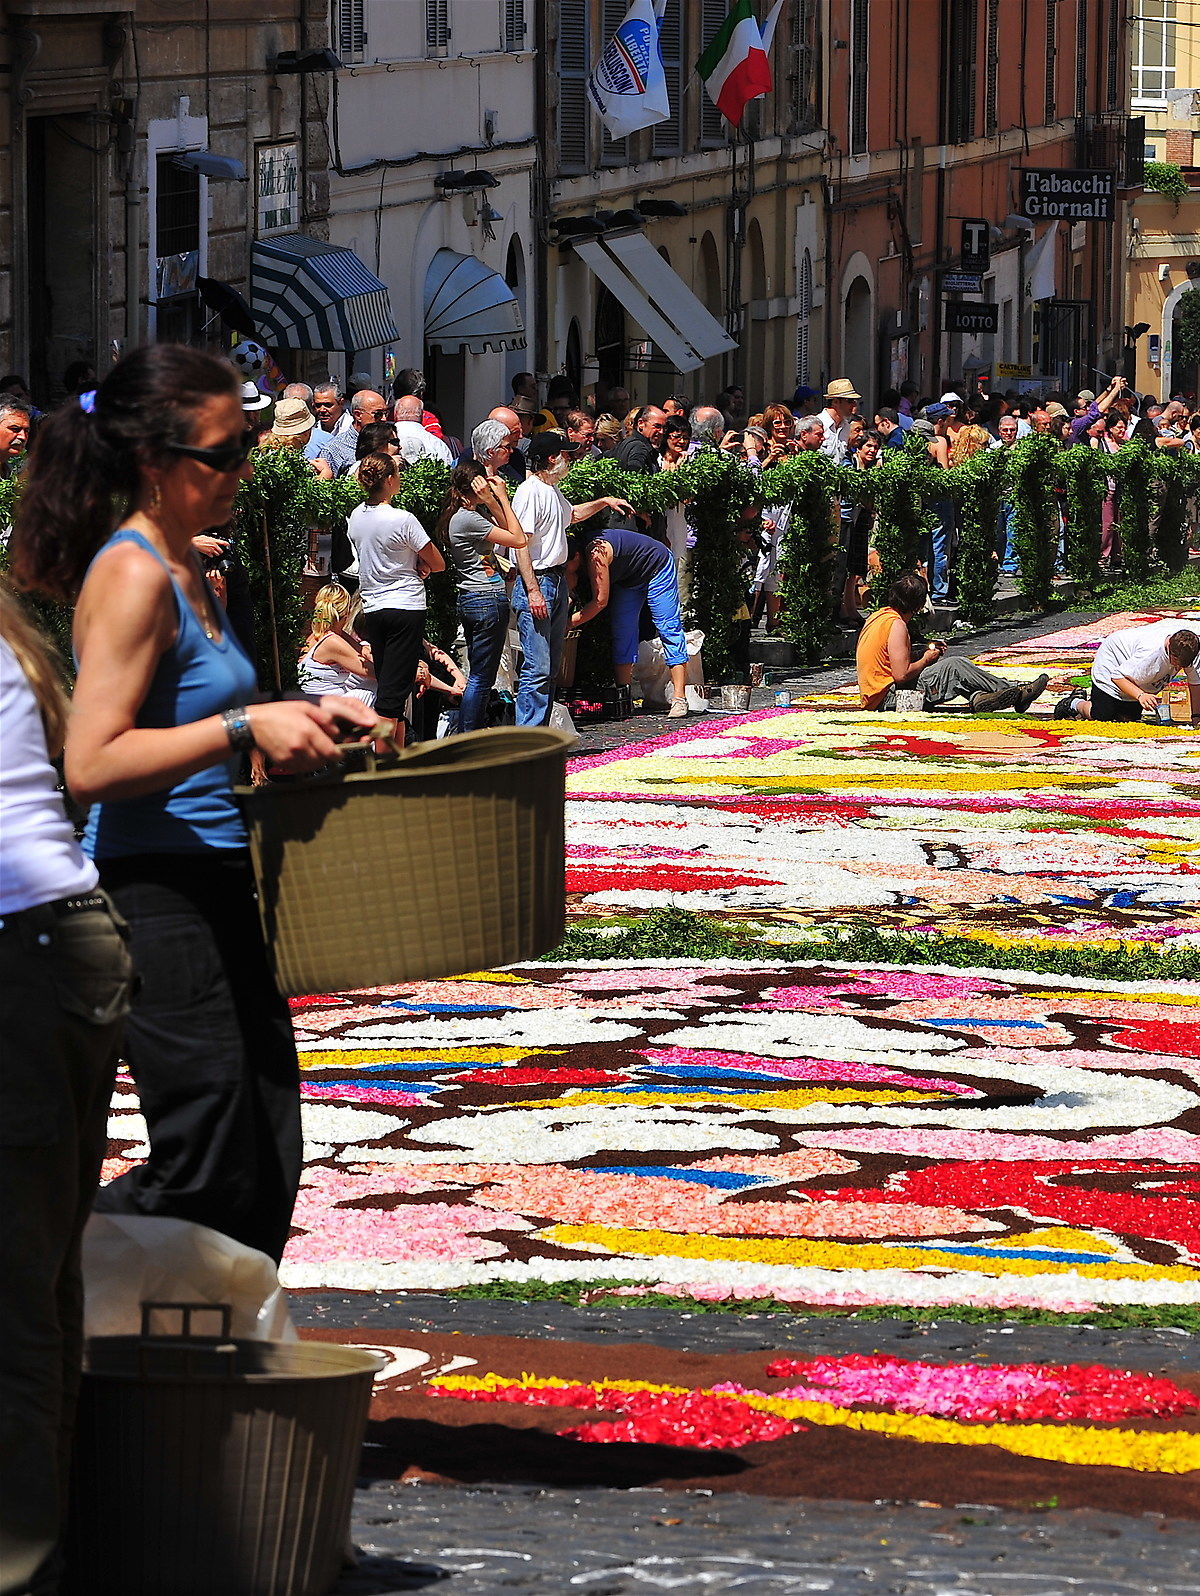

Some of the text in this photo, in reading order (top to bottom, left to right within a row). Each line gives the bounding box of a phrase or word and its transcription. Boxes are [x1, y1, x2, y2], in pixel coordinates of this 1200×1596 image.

[1025, 172, 1111, 195] Tabacchi
[1025, 195, 1107, 218] Giornali
[965, 223, 986, 254] T
[956, 314, 993, 329] LOTTO
